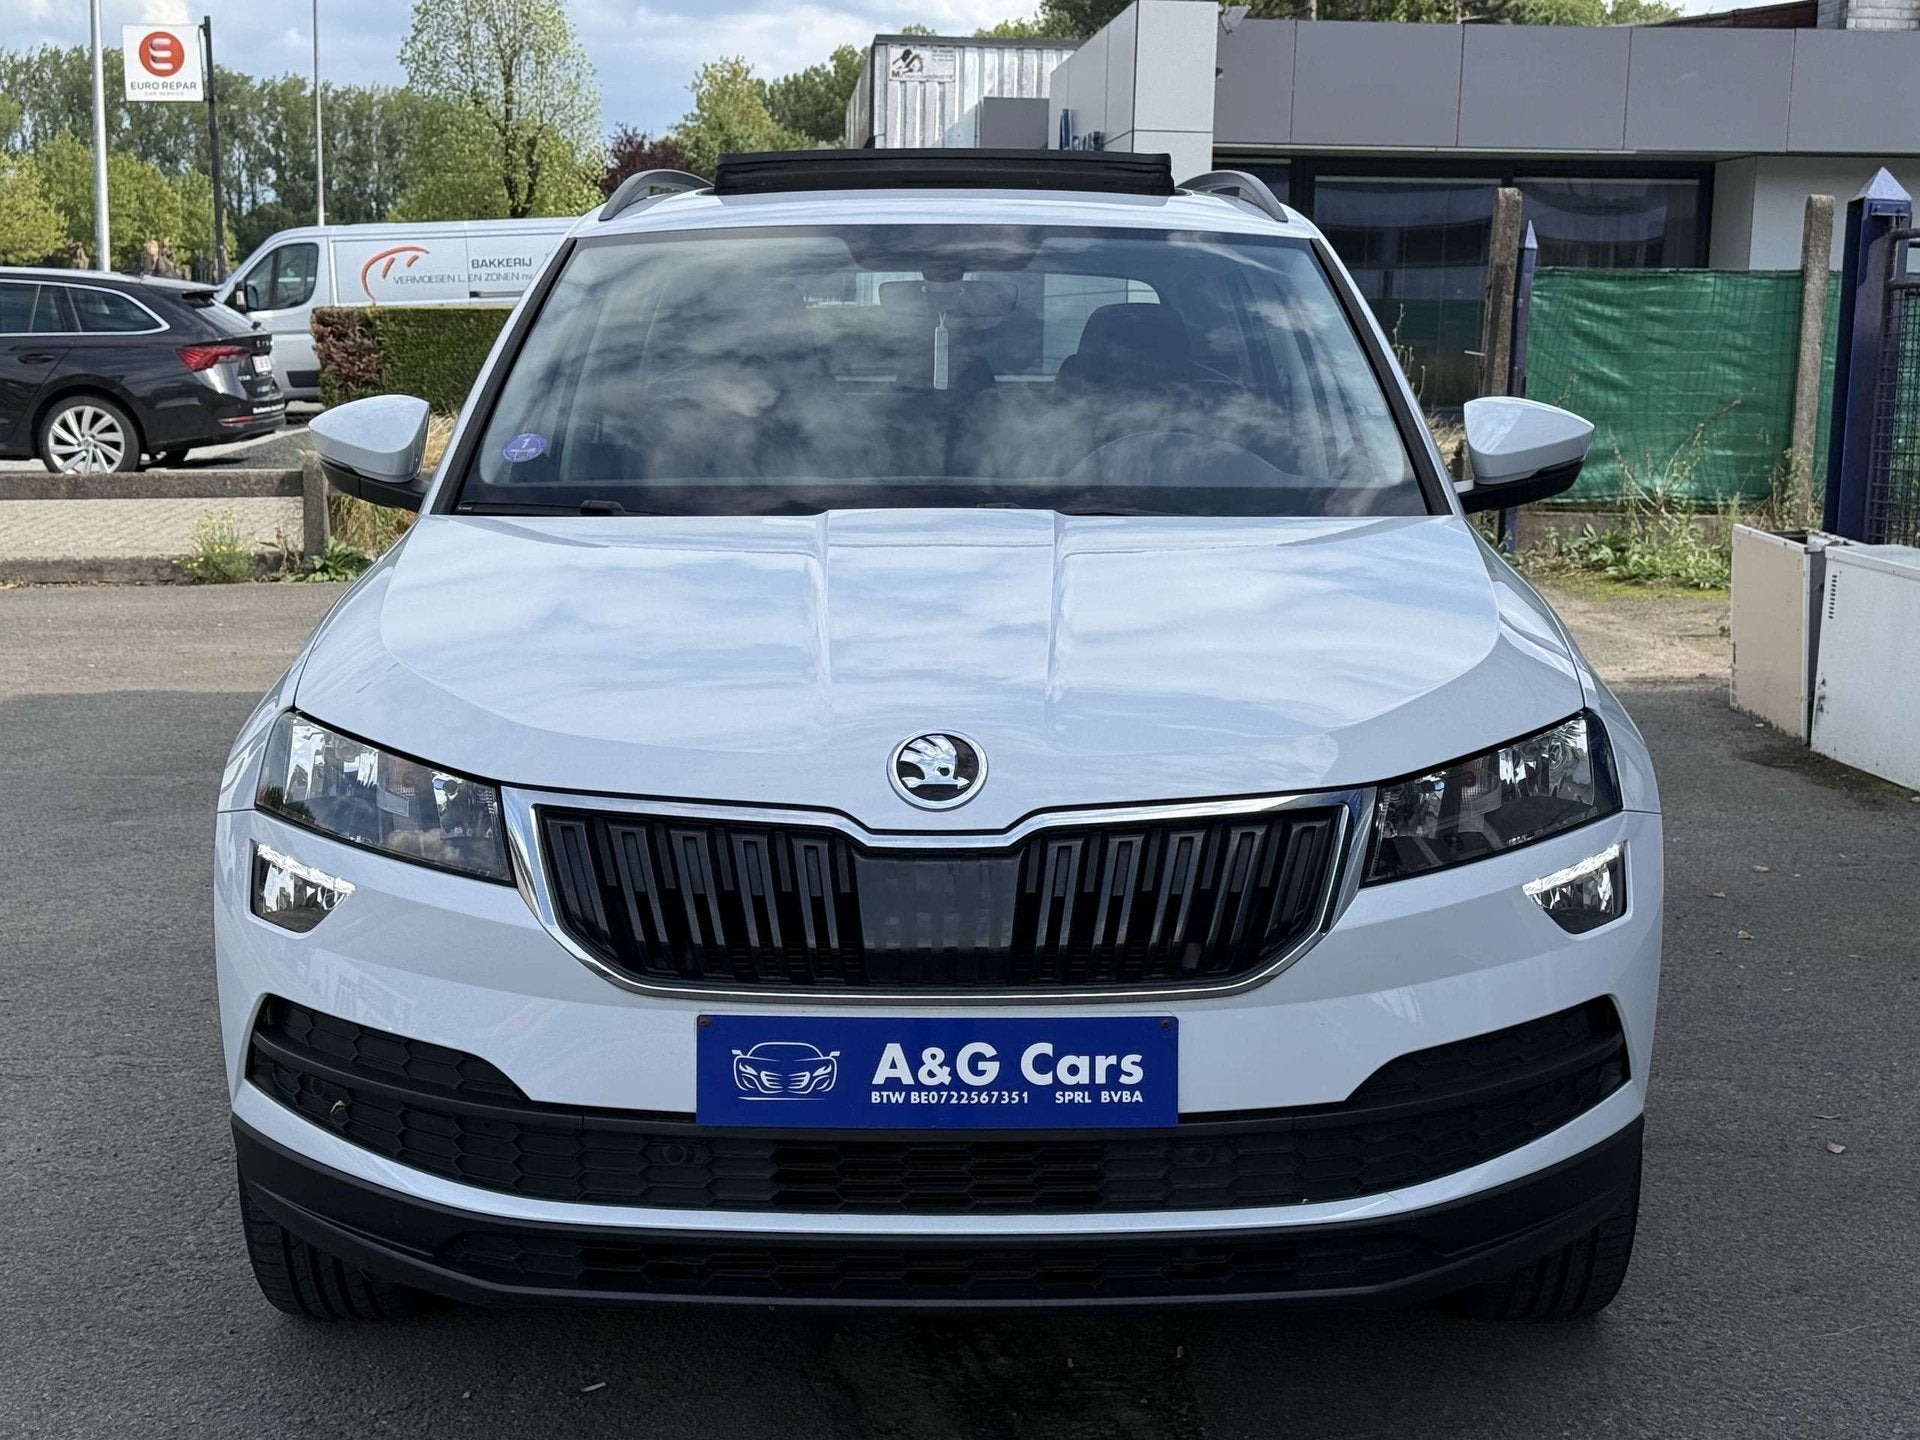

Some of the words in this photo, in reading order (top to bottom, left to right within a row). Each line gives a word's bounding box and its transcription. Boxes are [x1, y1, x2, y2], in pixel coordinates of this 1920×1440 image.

[130, 81, 160, 91] EURO
[161, 81, 197, 90] REPAR
[471, 257, 532, 269] BAKKERIJ
[393, 274, 456, 285] VERMOESEN
[468, 274, 482, 283] EN
[485, 272, 519, 282] ZONEN
[871, 1041, 1000, 1087] A&G
[1020, 1042, 1144, 1086] Cars
[871, 1091, 905, 1104] BTW
[910, 1091, 1029, 1104] BE0722567351
[1055, 1091, 1092, 1104] SPRL
[1101, 1091, 1143, 1103] BVBA
